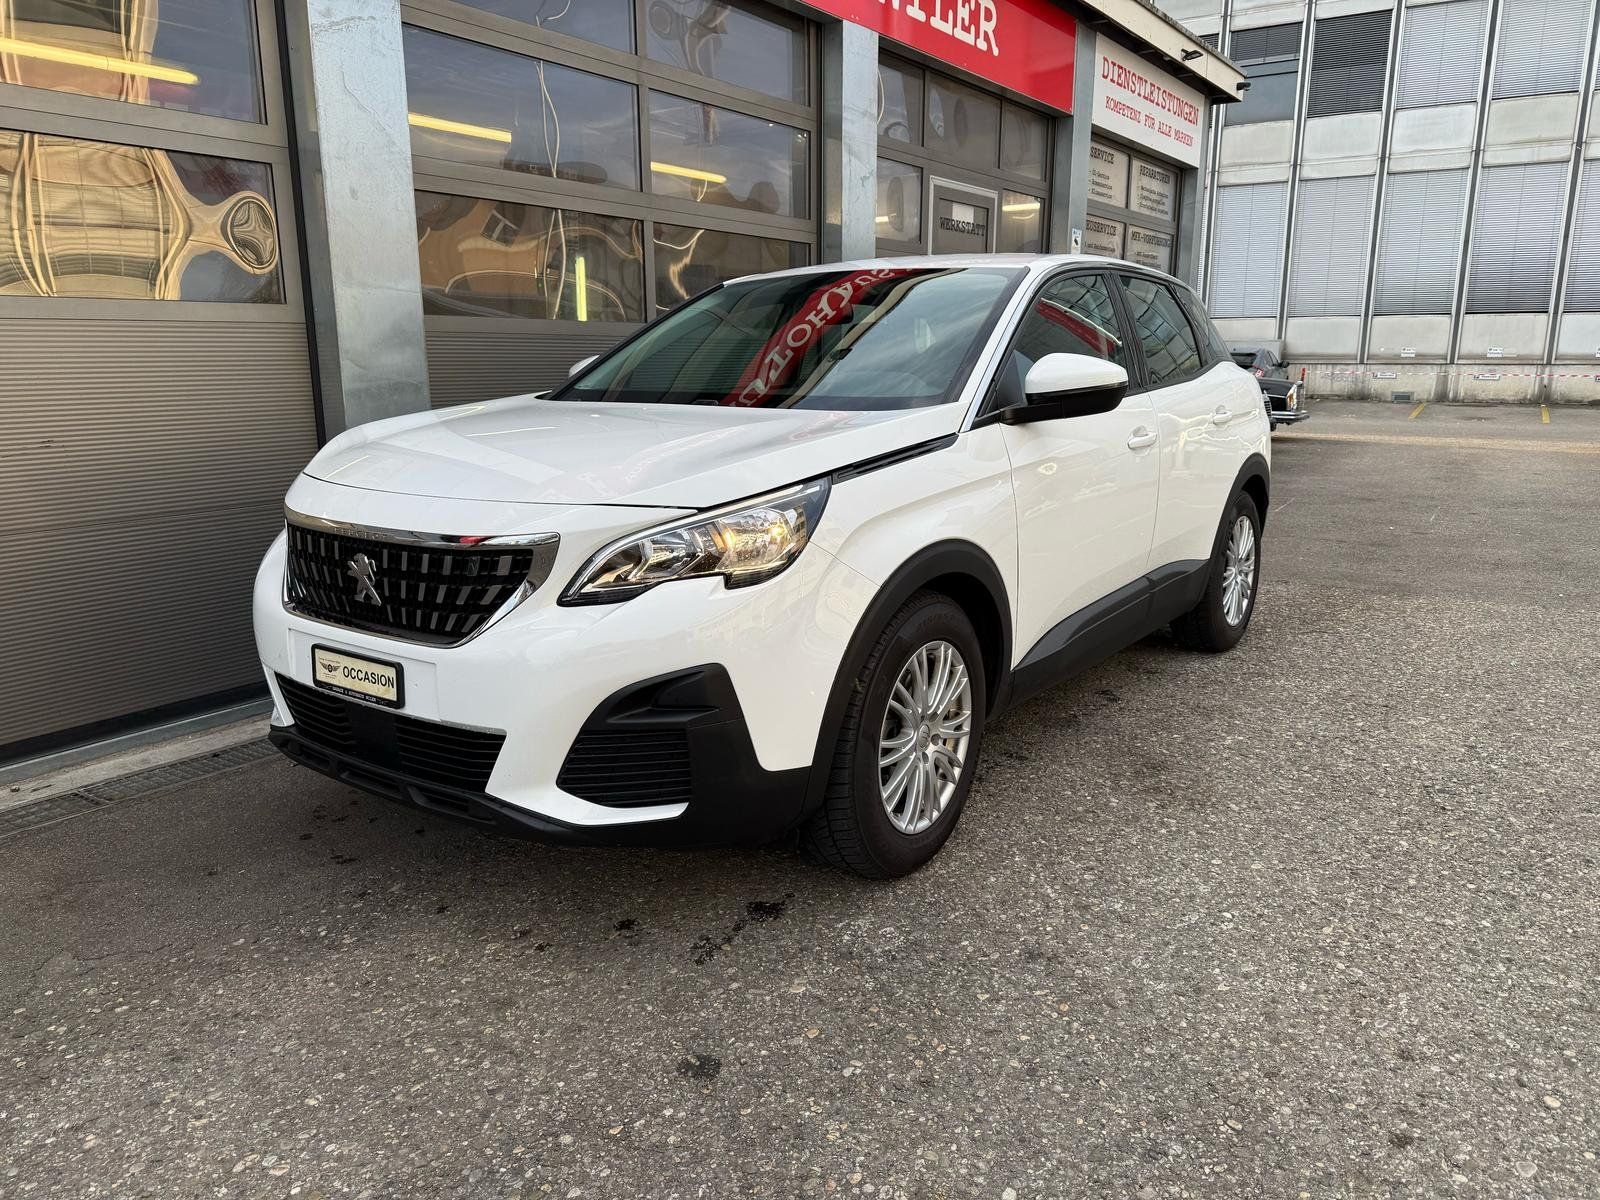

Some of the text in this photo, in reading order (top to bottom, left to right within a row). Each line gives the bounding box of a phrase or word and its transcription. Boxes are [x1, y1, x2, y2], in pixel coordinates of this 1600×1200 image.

[1102, 56, 1199, 126] DIENSTLEISTUNGEN
[1105, 96, 1194, 147] KOMPETENZ FÜR ALLE MARKEN
[939, 216, 986, 237] WERKSTATT
[343, 666, 395, 688] OCCASION
